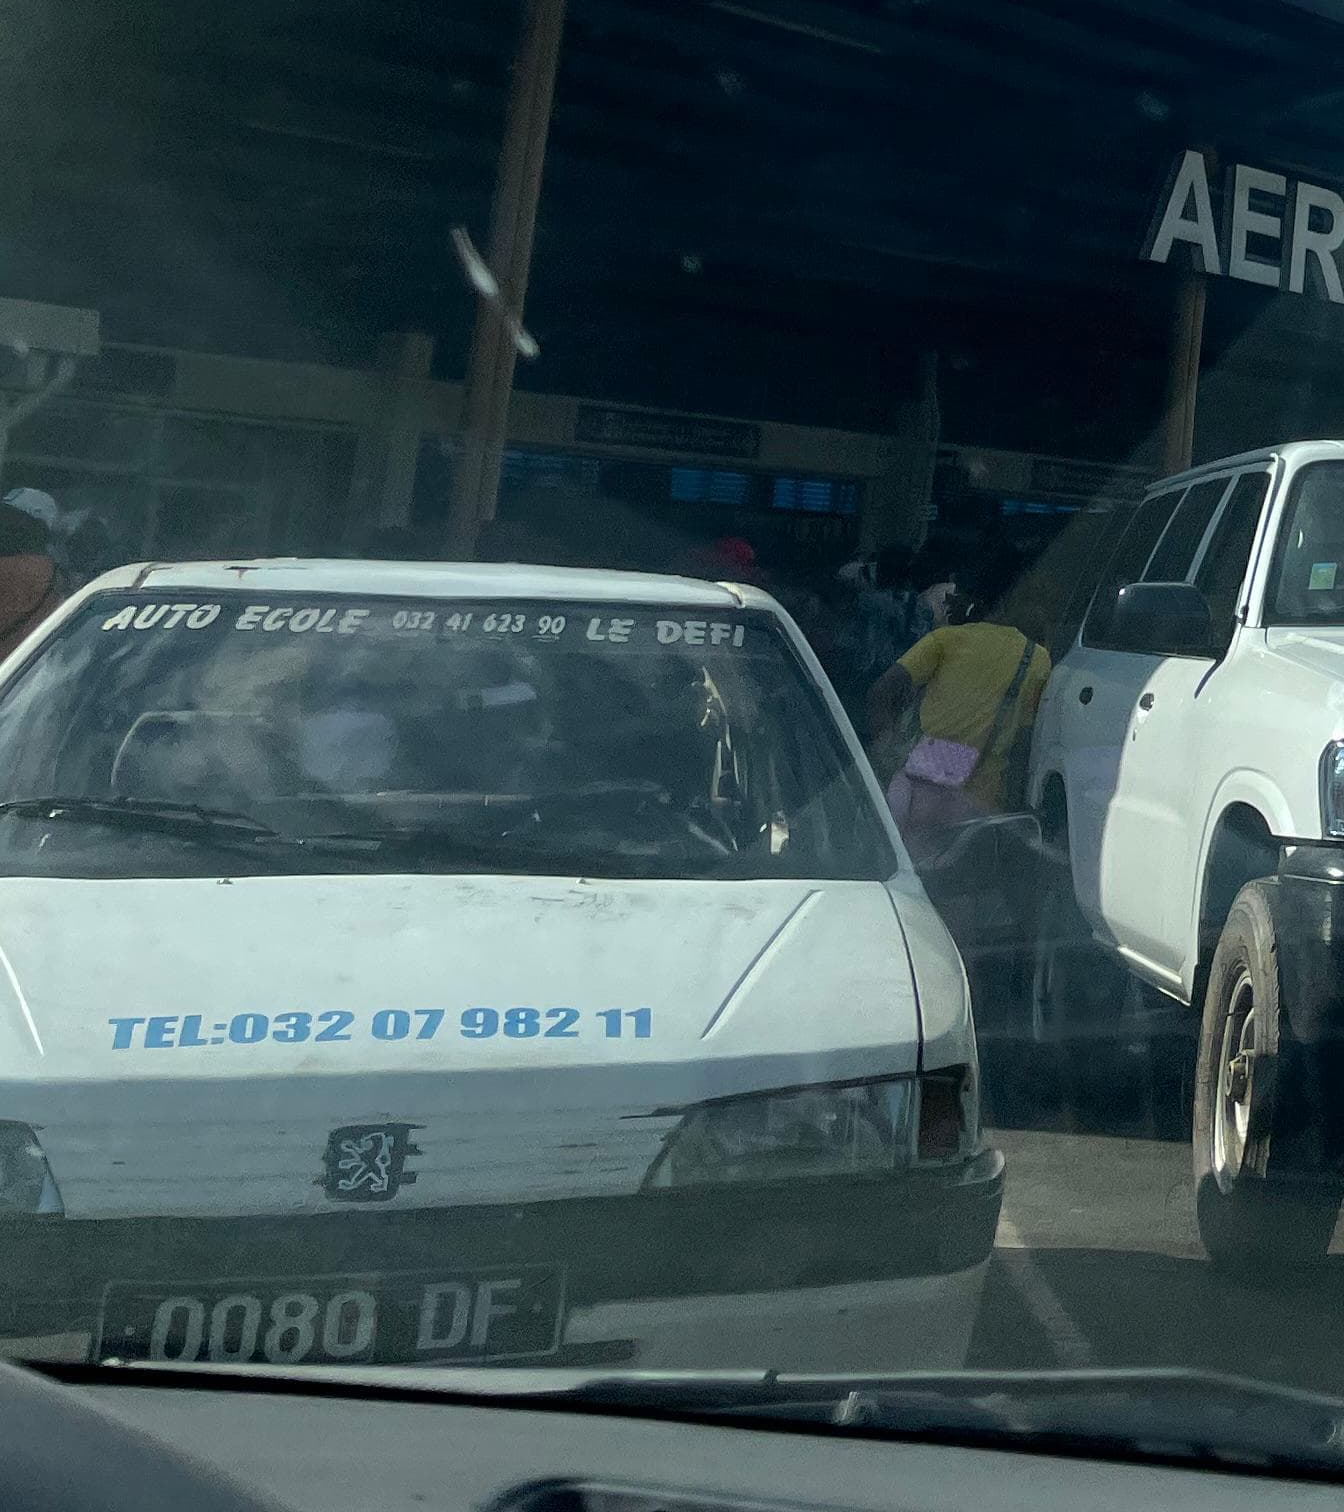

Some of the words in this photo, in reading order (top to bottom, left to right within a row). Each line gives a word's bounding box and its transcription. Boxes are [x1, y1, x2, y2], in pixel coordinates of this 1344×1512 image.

[102, 604, 222, 631] AUTO
[235, 605, 370, 634] ECOLE
[392, 611, 436, 630] 032
[446, 613, 473, 631] 41
[482, 613, 526, 634] 623
[537, 615, 566, 635] 90
[586, 618, 635, 643] LE
[656, 620, 745, 647] DEFI
[108, 1010, 355, 1050] TEL:032
[371, 1008, 445, 1041] 07
[459, 1007, 580, 1039] 982
[596, 1007, 652, 1039] 11
[150, 1290, 380, 1364] 0080
[416, 1279, 523, 1351] DF
